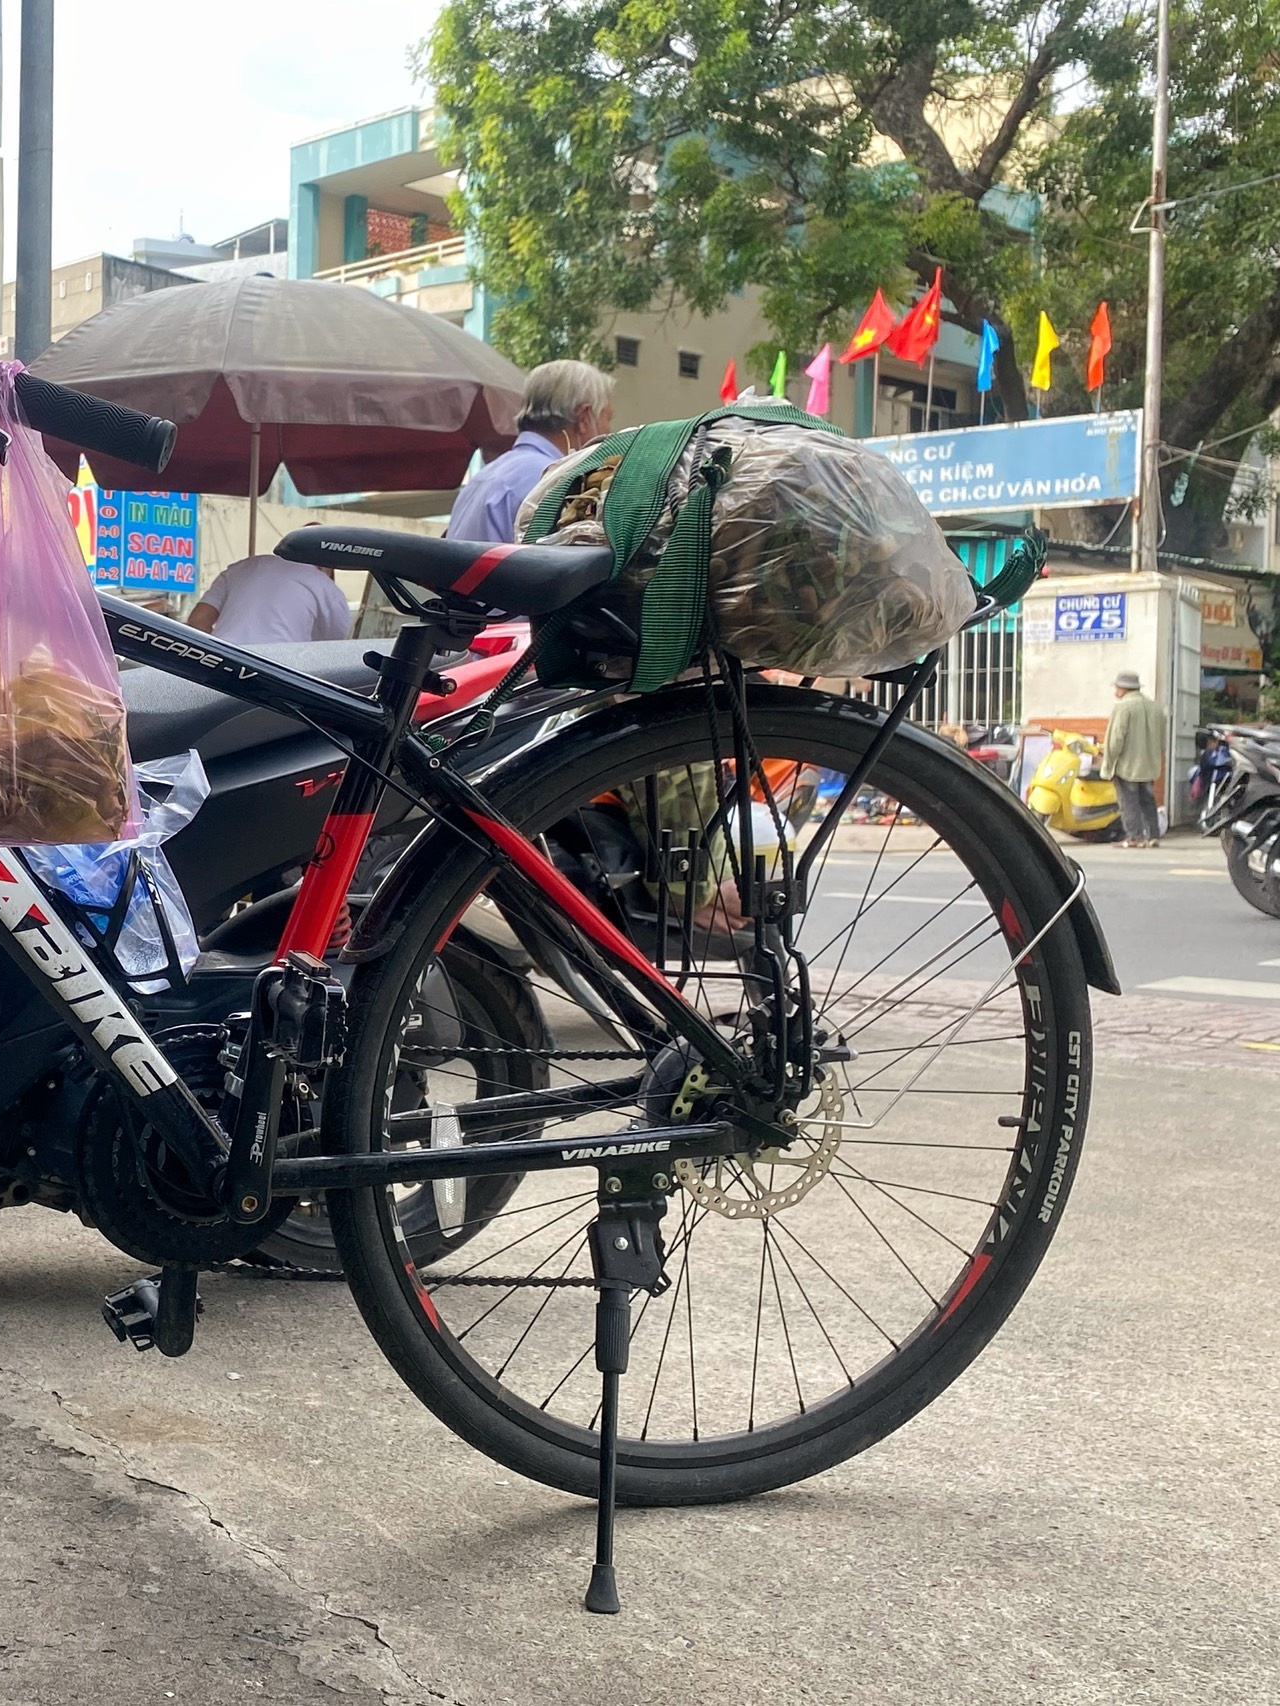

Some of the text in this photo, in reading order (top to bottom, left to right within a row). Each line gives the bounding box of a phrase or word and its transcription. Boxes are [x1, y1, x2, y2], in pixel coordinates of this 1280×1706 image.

[128, 501, 193, 528] IN MÀU
[128, 531, 194, 559] SCAN
[320, 541, 384, 558] VINABIKE
[1058, 597, 1100, 612] CHUNG
[1058, 609, 1122, 632] 675
[1037, 1030, 1081, 1224] CST CITY PARKOUR
[561, 1140, 671, 1161] VINABIKE
